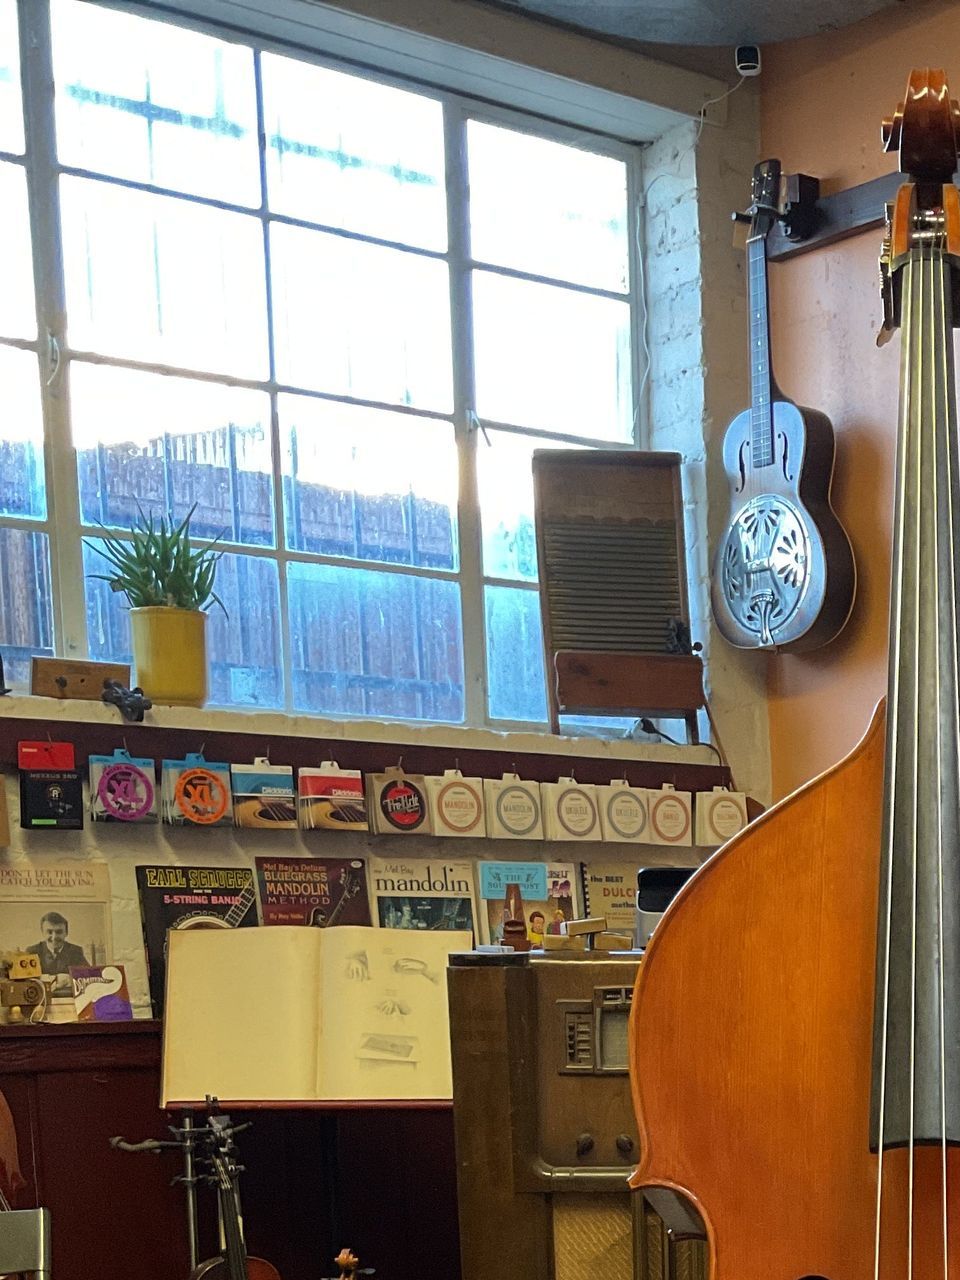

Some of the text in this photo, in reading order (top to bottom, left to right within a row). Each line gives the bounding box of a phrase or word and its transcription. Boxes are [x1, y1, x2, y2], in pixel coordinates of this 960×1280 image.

[112, 779, 144, 803] XL
[186, 783, 214, 808] XL
[444, 800, 475, 810] MANDOLIN
[503, 803, 533, 813] MANDOLIN
[565, 806, 588, 816] UKULELE
[615, 808, 639, 818] UKULELE
[263, 863, 277, 872] Mel
[279, 863, 299, 873] Bay's
[384, 864, 399, 874] Mel
[1, 869, 94, 878] DON'T LET THE SUN
[146, 868, 253, 889] EARL SCRUGGS
[264, 871, 328, 882] BLUEGRASS
[376, 865, 470, 892] mandolin
[1, 877, 94, 887] CATCH YOU CRYING
[590, 875, 603, 883] the
[266, 883, 330, 896] MANDOLIN
[164, 895, 241, 905] 5-STRING BANJO
[267, 896, 331, 905] METHOD
